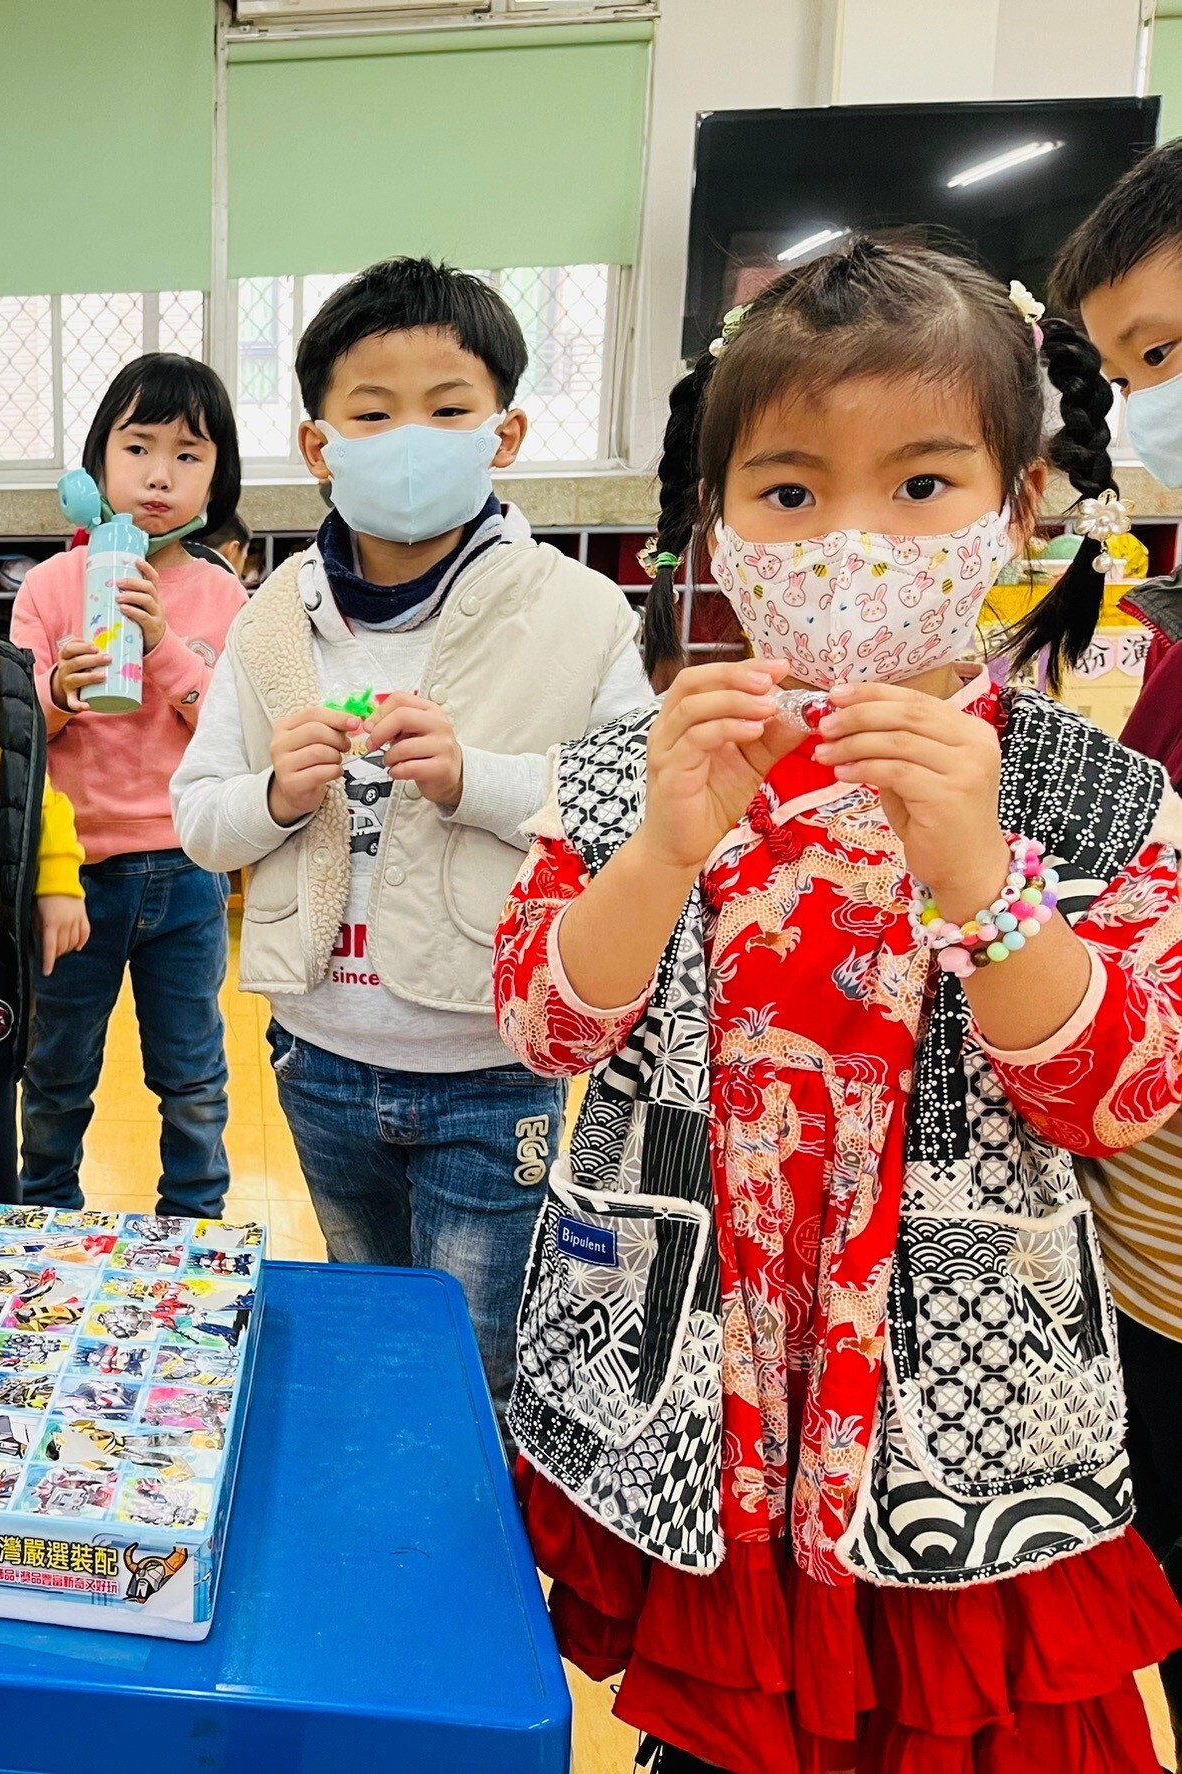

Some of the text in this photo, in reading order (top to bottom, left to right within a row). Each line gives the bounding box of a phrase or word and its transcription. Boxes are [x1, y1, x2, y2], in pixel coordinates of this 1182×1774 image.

[332, 966, 380, 986] since
[514, 1114, 550, 1187] EGO
[562, 1227, 607, 1254] Bipulent
